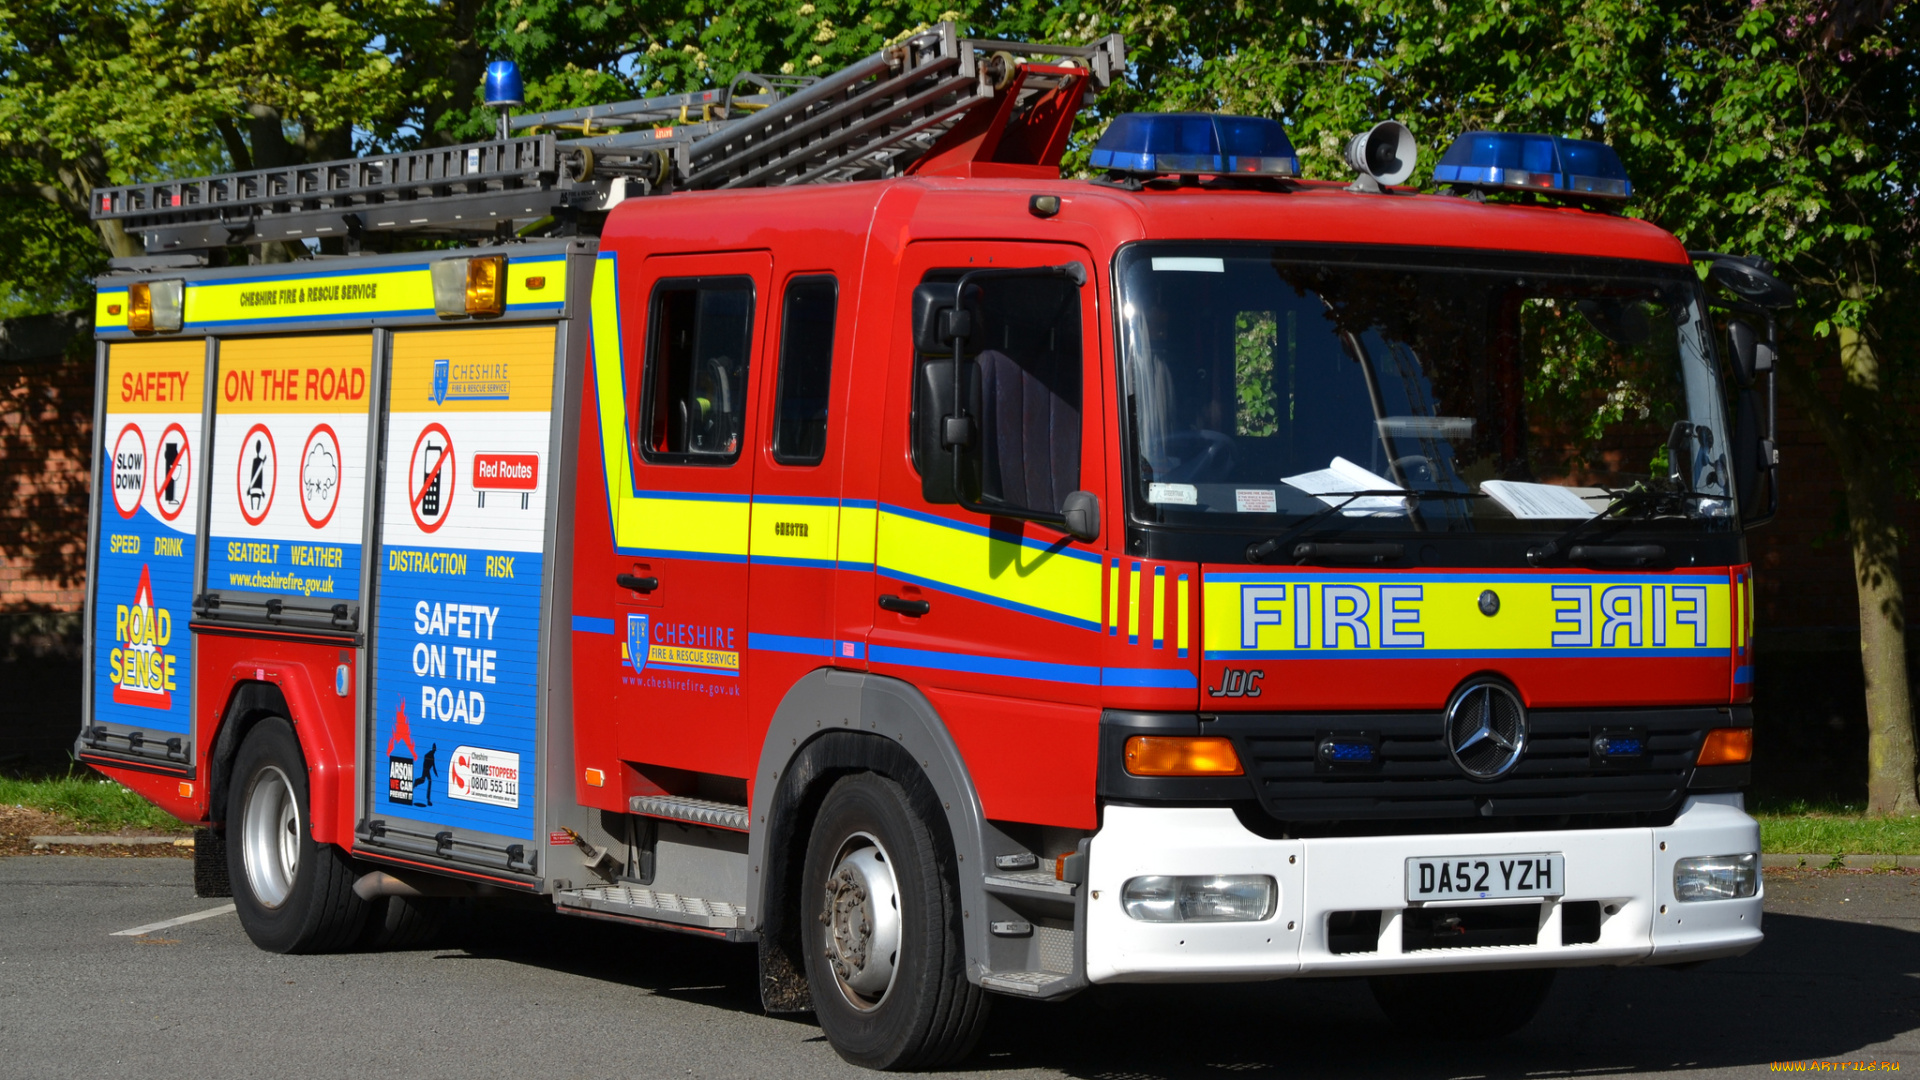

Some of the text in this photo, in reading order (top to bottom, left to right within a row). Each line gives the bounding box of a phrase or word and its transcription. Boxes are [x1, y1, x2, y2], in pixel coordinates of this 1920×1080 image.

[240, 283, 377, 307] CHESHIRE FIRE & RESCUE SERVICE
[452, 363, 508, 380] CHESHIRE
[121, 371, 189, 402] SAFETY
[224, 367, 365, 402] ON THE ROAD
[452, 384, 462, 392] FIRE
[468, 384, 486, 392] RESCUE
[487, 383, 507, 392] SERVICE
[116, 453, 143, 470] SLOW
[479, 460, 532, 478] Red Routes
[115, 474, 142, 490] DOWN
[775, 522, 808, 537] CHESTER
[110, 534, 184, 557] SPEED DRINK
[227, 542, 342, 568] SEATBELT WEATHER
[389, 550, 515, 578] DISTRACTION RISK
[229, 570, 334, 597] www.cheshirefire.gov.uk
[116, 604, 171, 647] ROAD
[414, 600, 500, 640] SAFETY
[1240, 584, 1425, 649] FIRE
[654, 622, 735, 649] CHESHIRE
[109, 647, 177, 691] SENSE
[412, 642, 496, 684] ON THE
[652, 648, 737, 666] FIRE & RESCUE SERVICE
[622, 676, 740, 697] www.cheshirefire.gov.uk
[421, 685, 486, 726] ROAD
[390, 761, 413, 781] ARSON
[471, 763, 517, 780] CRIMESTOPPERS
[400, 780, 413, 792] CAN
[471, 776, 516, 795] 0800 555 111
[1419, 859, 1551, 894] DA52 YZH
